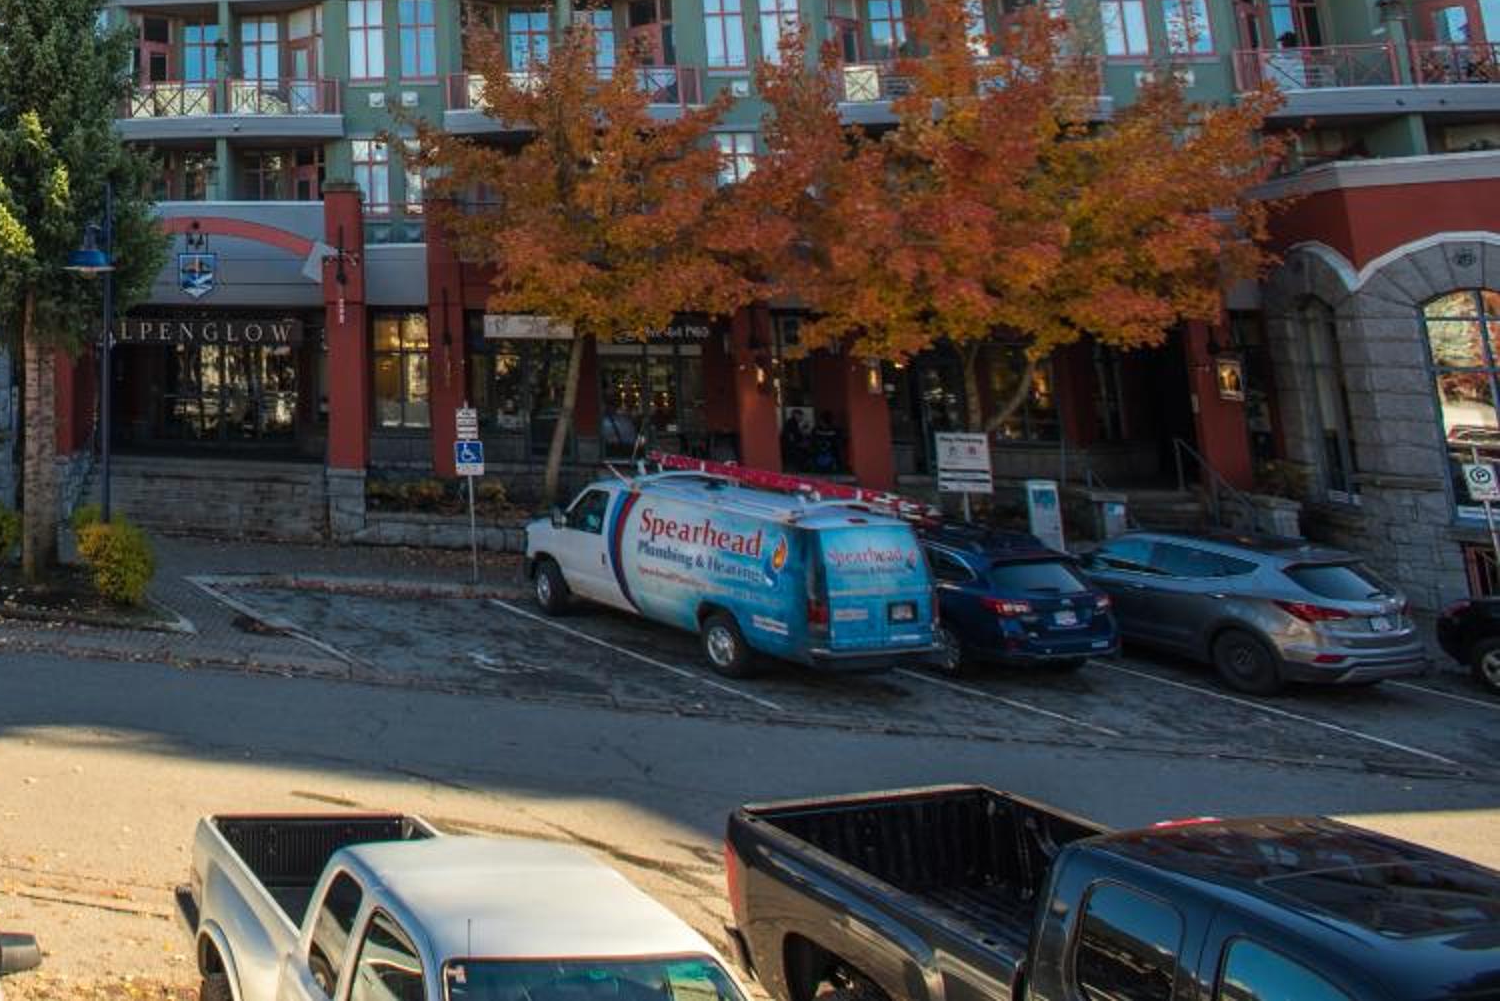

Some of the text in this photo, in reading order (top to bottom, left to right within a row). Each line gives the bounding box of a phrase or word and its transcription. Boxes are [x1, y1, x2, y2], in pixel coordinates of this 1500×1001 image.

[119, 320, 293, 343] LPENGLOW
[638, 507, 762, 559] Spearhead
[637, 539, 693, 570] Plumbing
[695, 554, 705, 569] &
